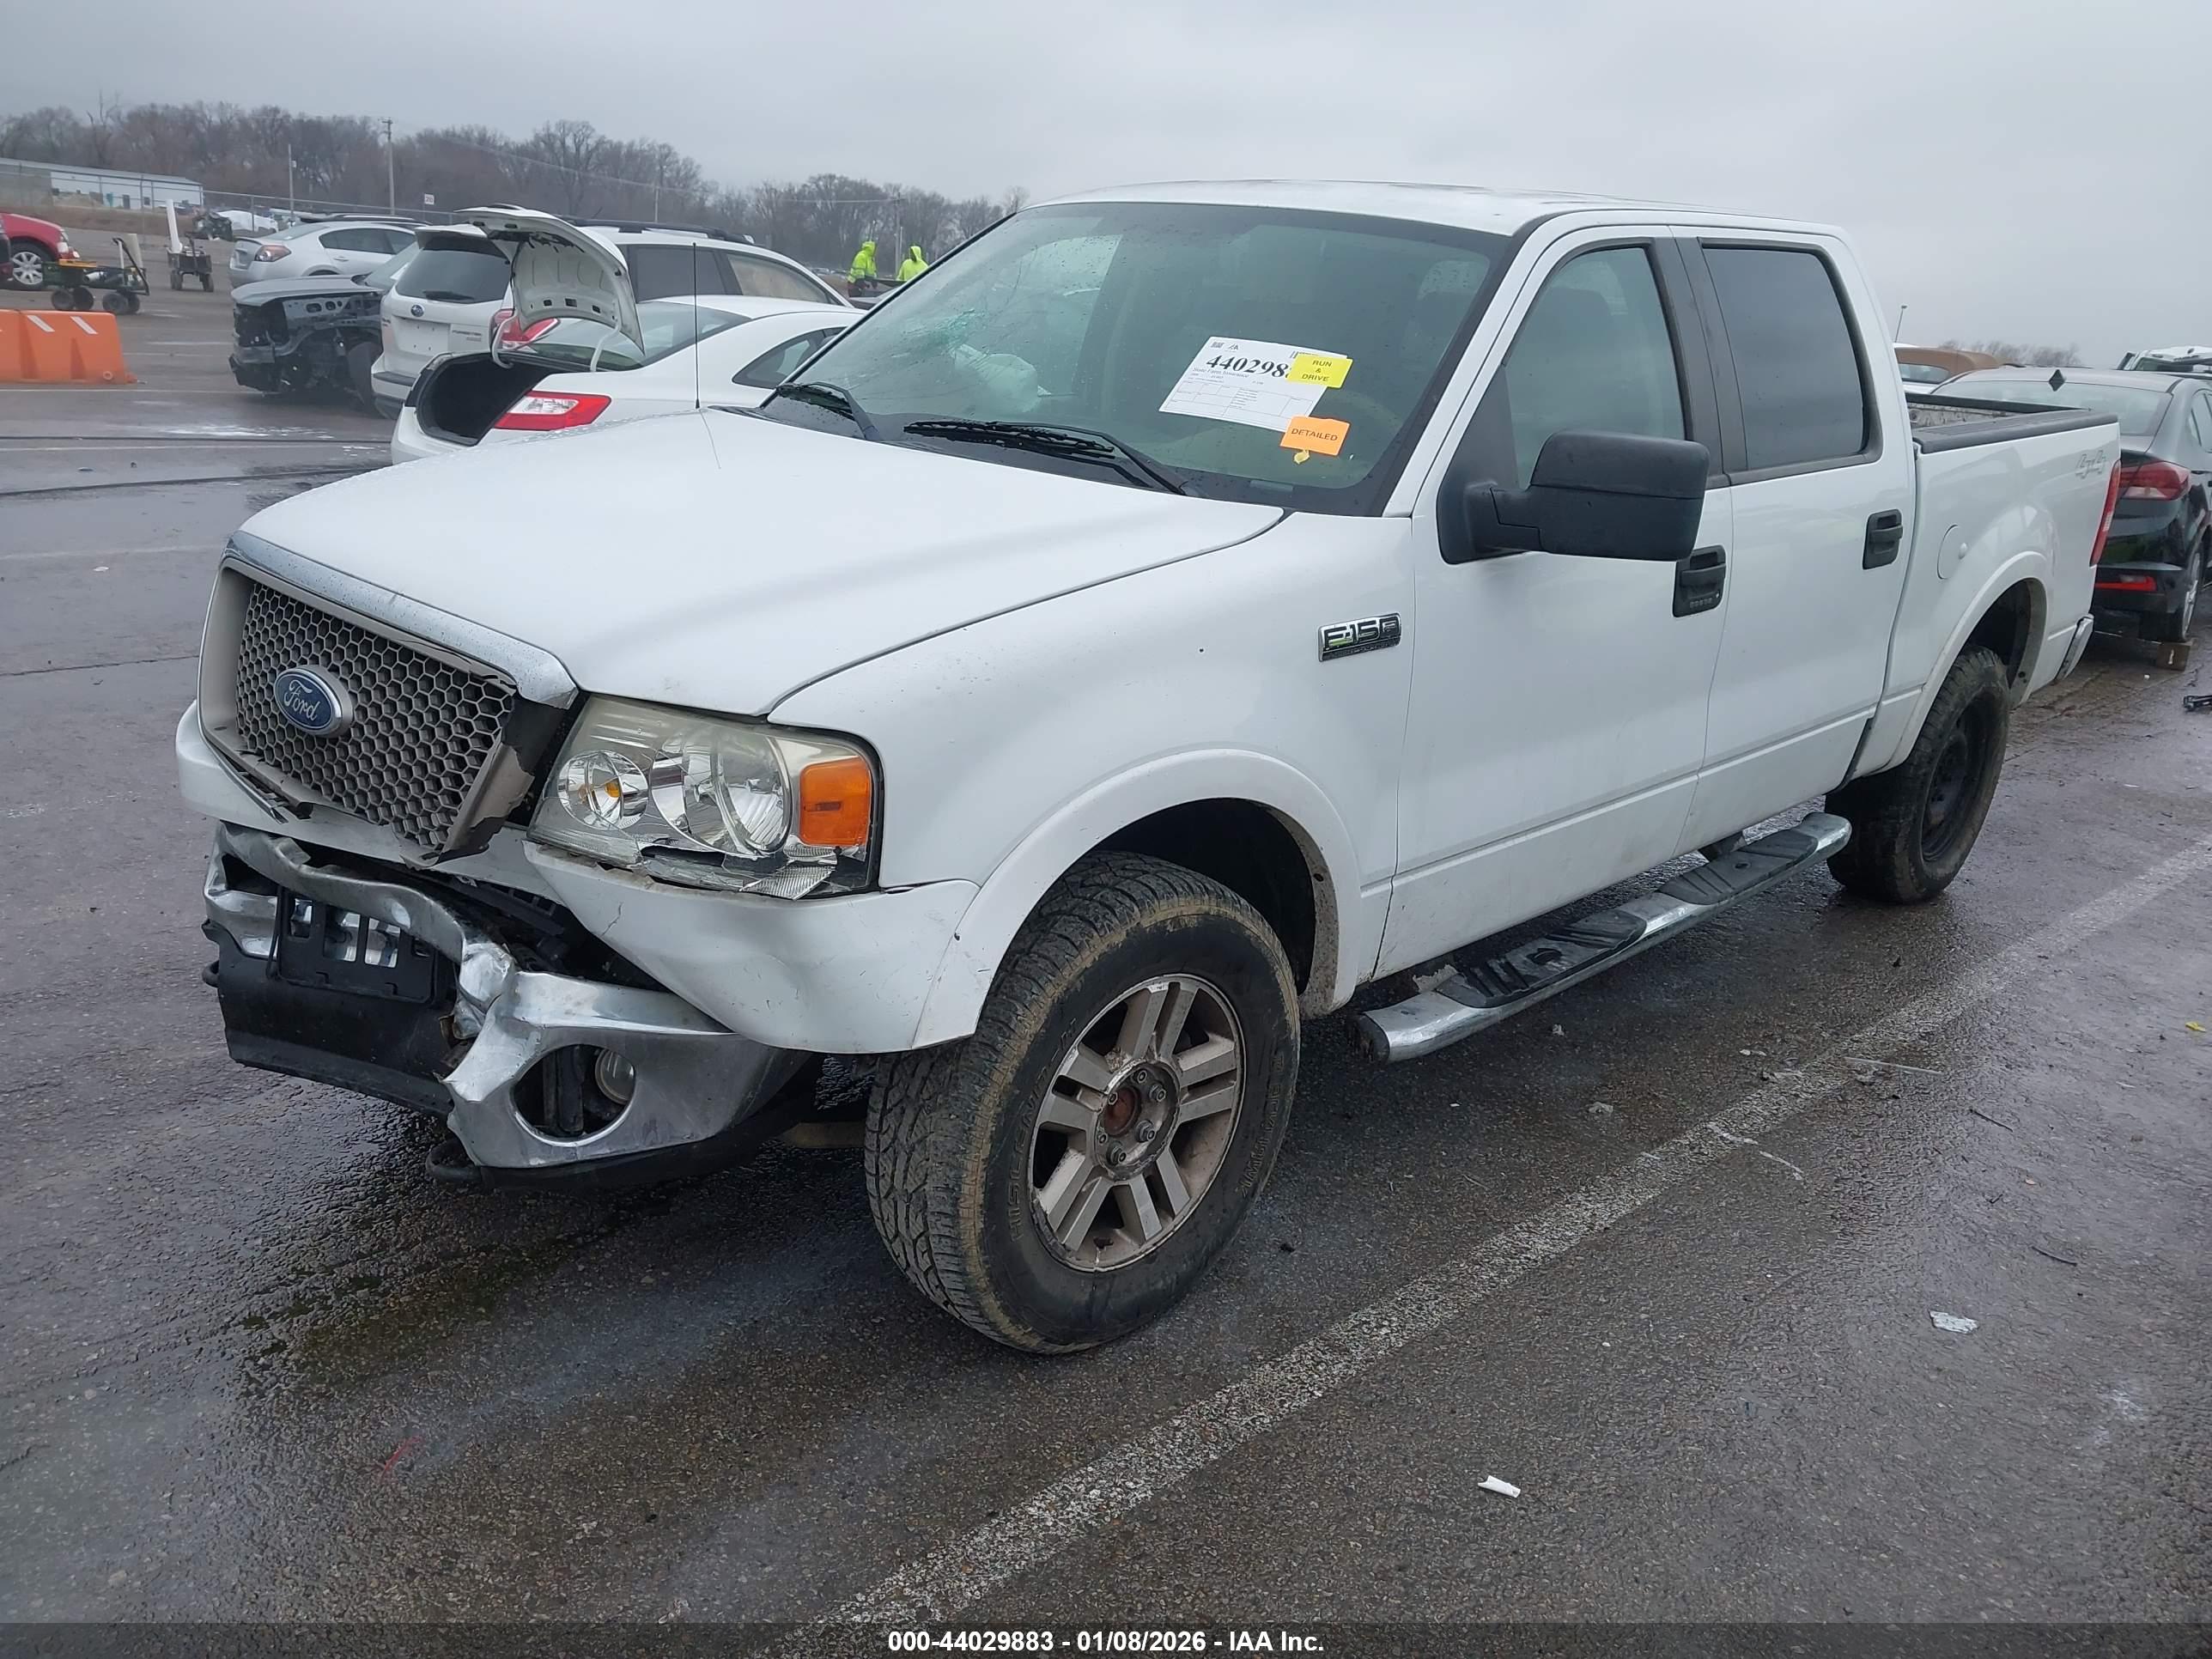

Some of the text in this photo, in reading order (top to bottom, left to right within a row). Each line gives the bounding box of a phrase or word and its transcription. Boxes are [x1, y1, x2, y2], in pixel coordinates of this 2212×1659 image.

[1302, 374, 1330, 382] DRIVE
[1291, 428, 1338, 441] DETAILED
[283, 679, 320, 721] Ford
